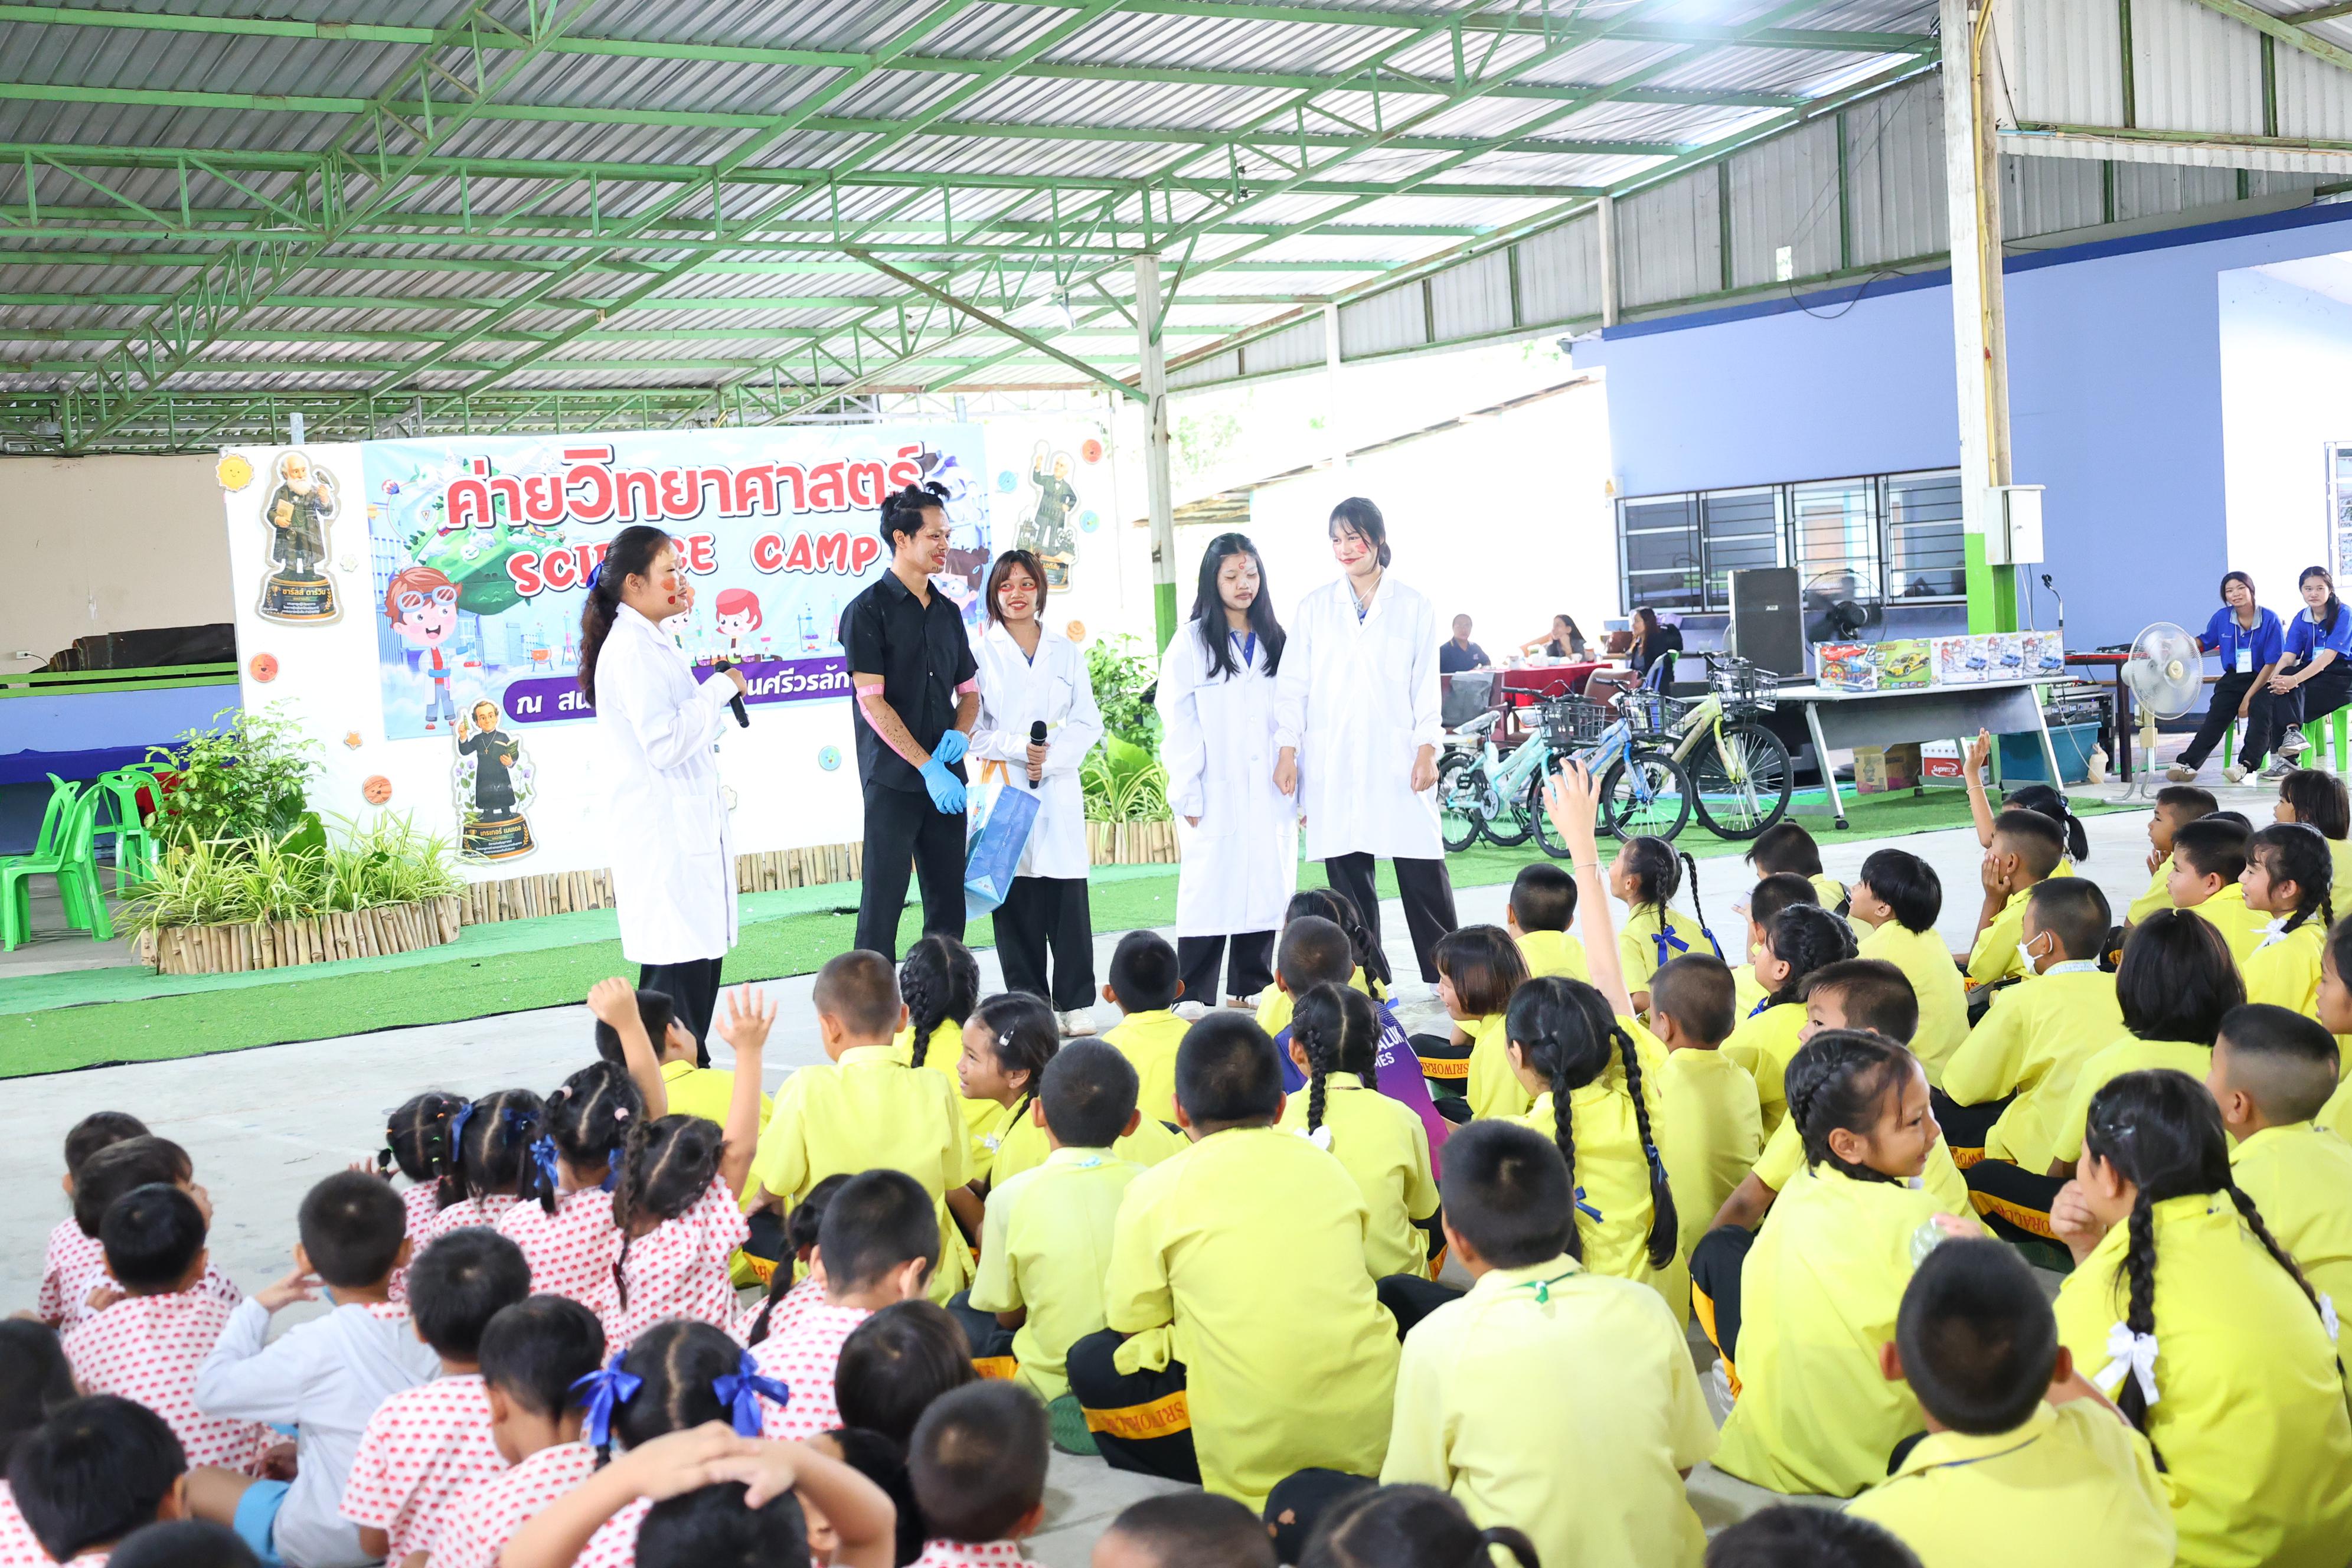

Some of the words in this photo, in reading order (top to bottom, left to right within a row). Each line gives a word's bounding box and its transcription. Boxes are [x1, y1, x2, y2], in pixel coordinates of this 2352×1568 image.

[446, 444, 921, 525] ค่ายวิทยาศาสตร์
[508, 534, 715, 594] SCIE
[752, 531, 880, 574] CAMP
[516, 695, 543, 715] ณ
